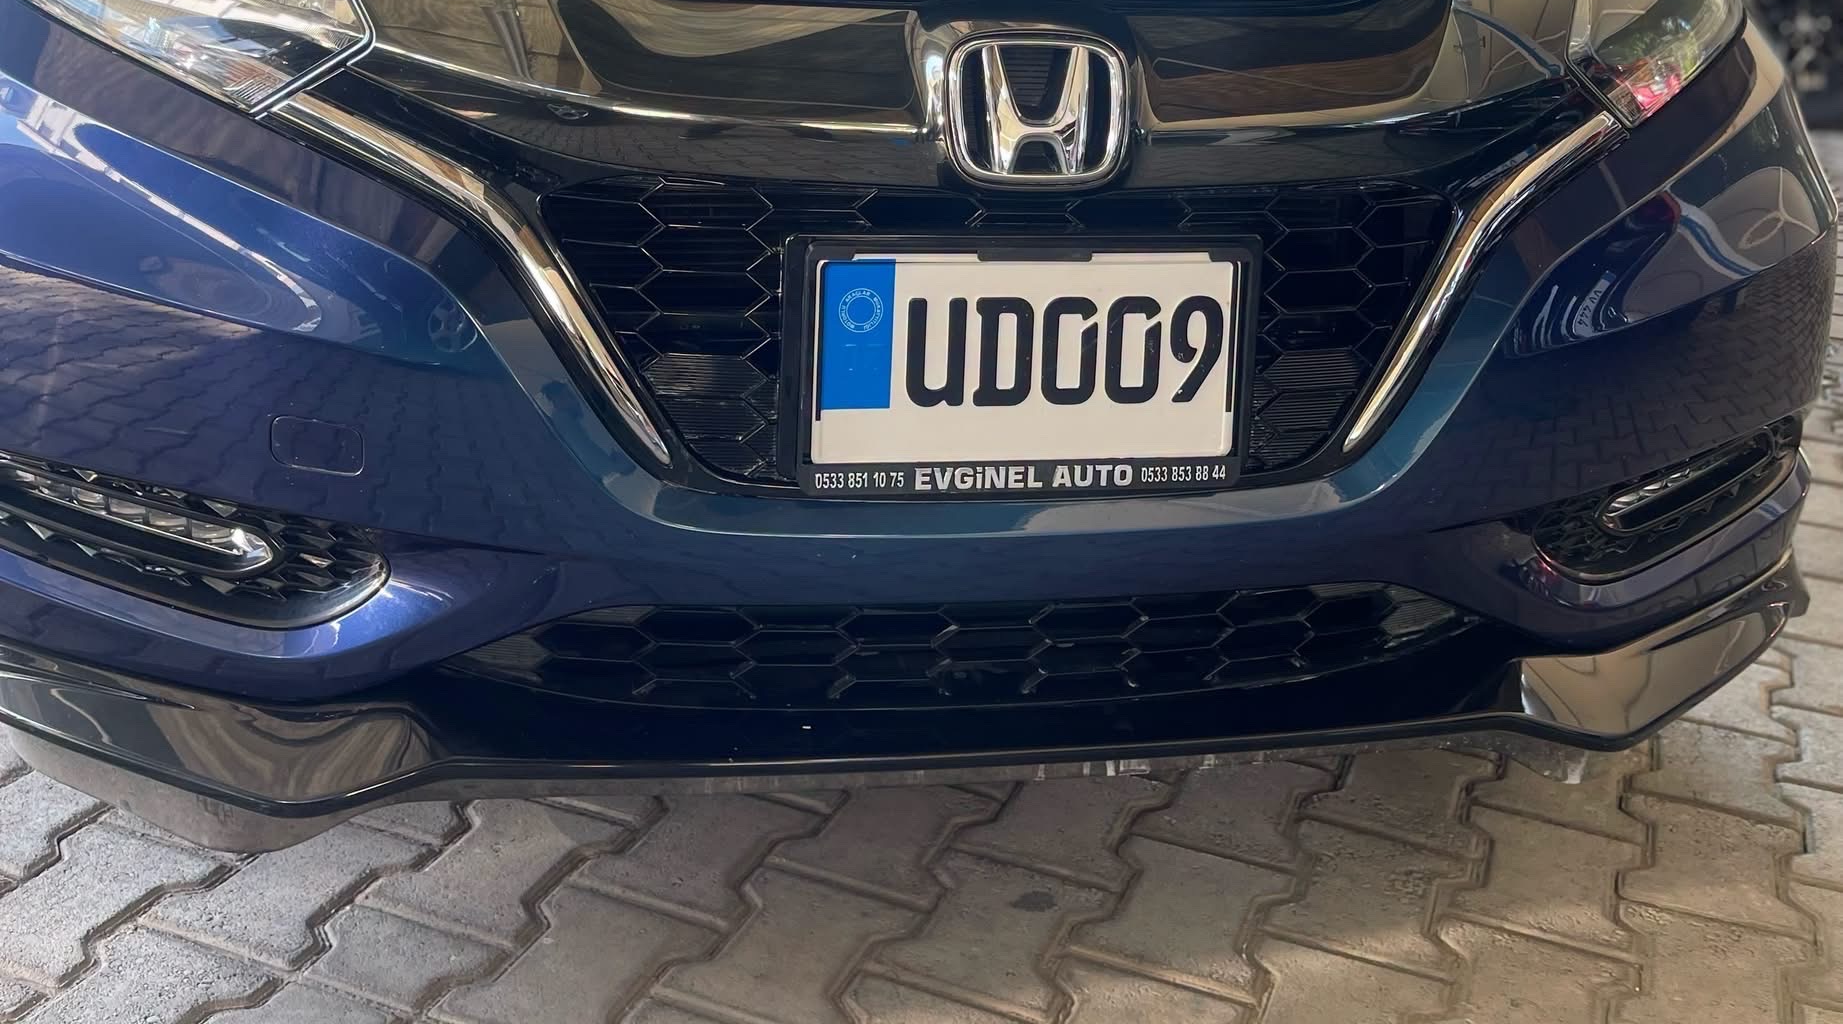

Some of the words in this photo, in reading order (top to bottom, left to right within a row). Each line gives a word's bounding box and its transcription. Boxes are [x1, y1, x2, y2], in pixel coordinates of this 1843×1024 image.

[905, 295, 1224, 407] UD009
[815, 473, 844, 489] 0533
[848, 472, 868, 488] 851
[873, 472, 886, 488] 10
[890, 472, 904, 488] 75
[1052, 464, 1133, 488] AUTO
[1141, 467, 1168, 483] 0533
[1171, 466, 1192, 482] 853
[1195, 465, 1209, 481] 88
[1212, 464, 1226, 480] 44
